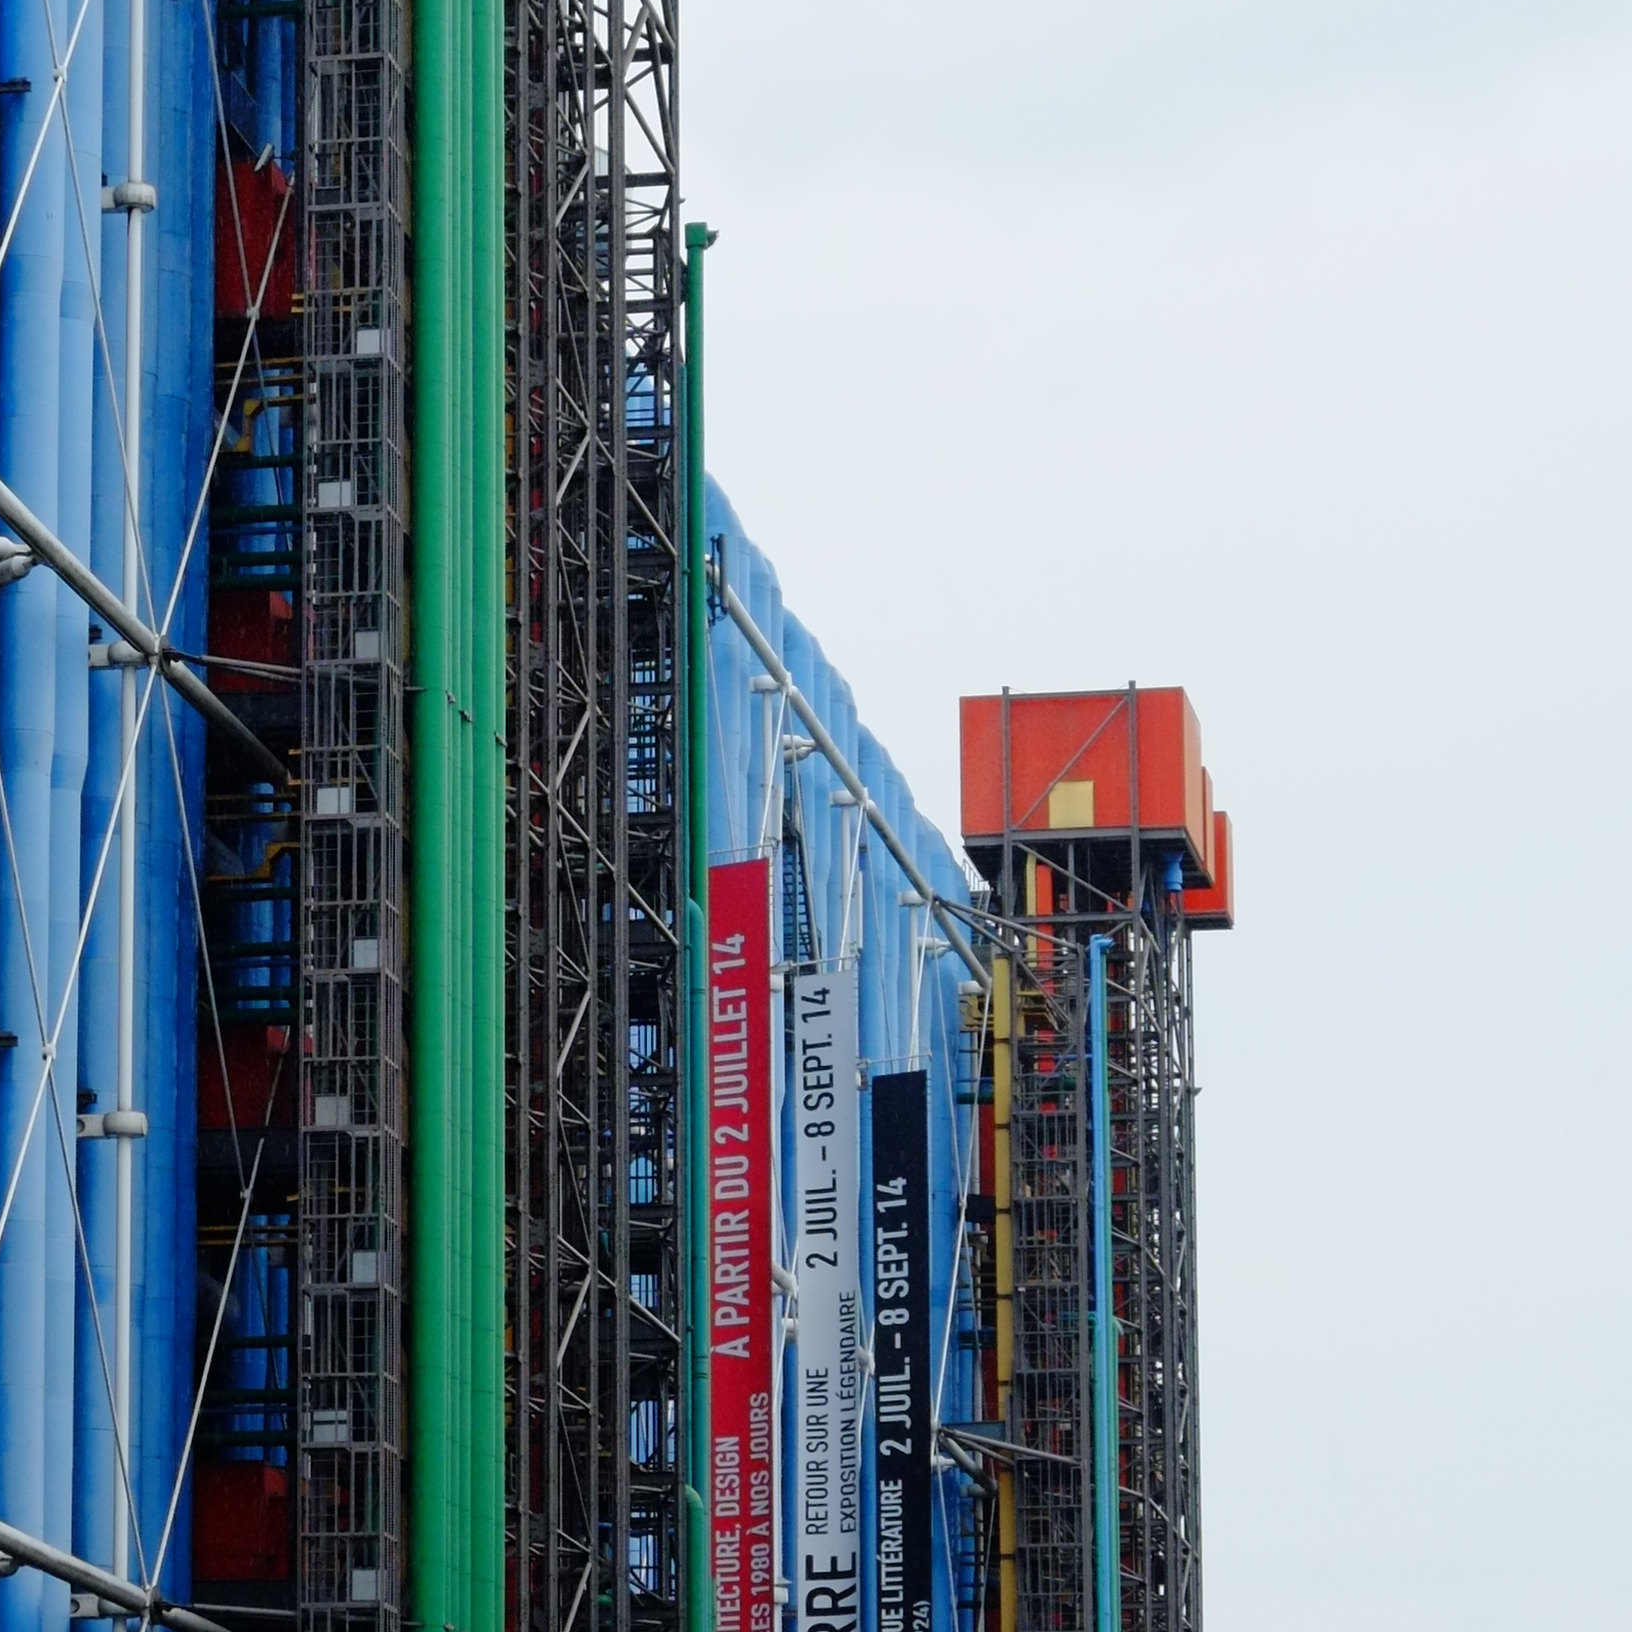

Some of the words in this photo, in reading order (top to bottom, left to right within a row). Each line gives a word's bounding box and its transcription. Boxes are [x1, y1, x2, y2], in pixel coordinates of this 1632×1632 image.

[711, 933, 746, 975] 14
[800, 987, 832, 1024] 14
[712, 985, 749, 1114] JUILLET
[801, 1033, 835, 1112] SEPT.
[713, 1122, 749, 1145] 2
[803, 1120, 836, 1139] 8
[714, 1154, 749, 1200] DU
[876, 1176, 909, 1214] 14
[804, 1169, 838, 1241] JUIL.
[714, 1210, 750, 1326] PARTIR
[805, 1251, 838, 1269] 2
[876, 1222, 910, 1299] SEPT.
[878, 1307, 911, 1326] 8
[711, 1334, 750, 1359] À
[835, 1291, 857, 1412] LÉGENDAIRE
[805, 1367, 829, 1407] UNE
[878, 1356, 912, 1430] JUIL.
[749, 1392, 770, 1464] JOURS
[805, 1413, 830, 1454] SUR
[879, 1437, 913, 1457] 2
[715, 1436, 741, 1516] DESIGN
[750, 1470, 770, 1515] NOS
[805, 1460, 829, 1536] RETOUR
[839, 1418, 857, 1534] EXPOSITION
[745, 1521, 770, 1537] À
[876, 1479, 904, 1603] LITTÉRATURE
[750, 1543, 770, 1596] 1980
